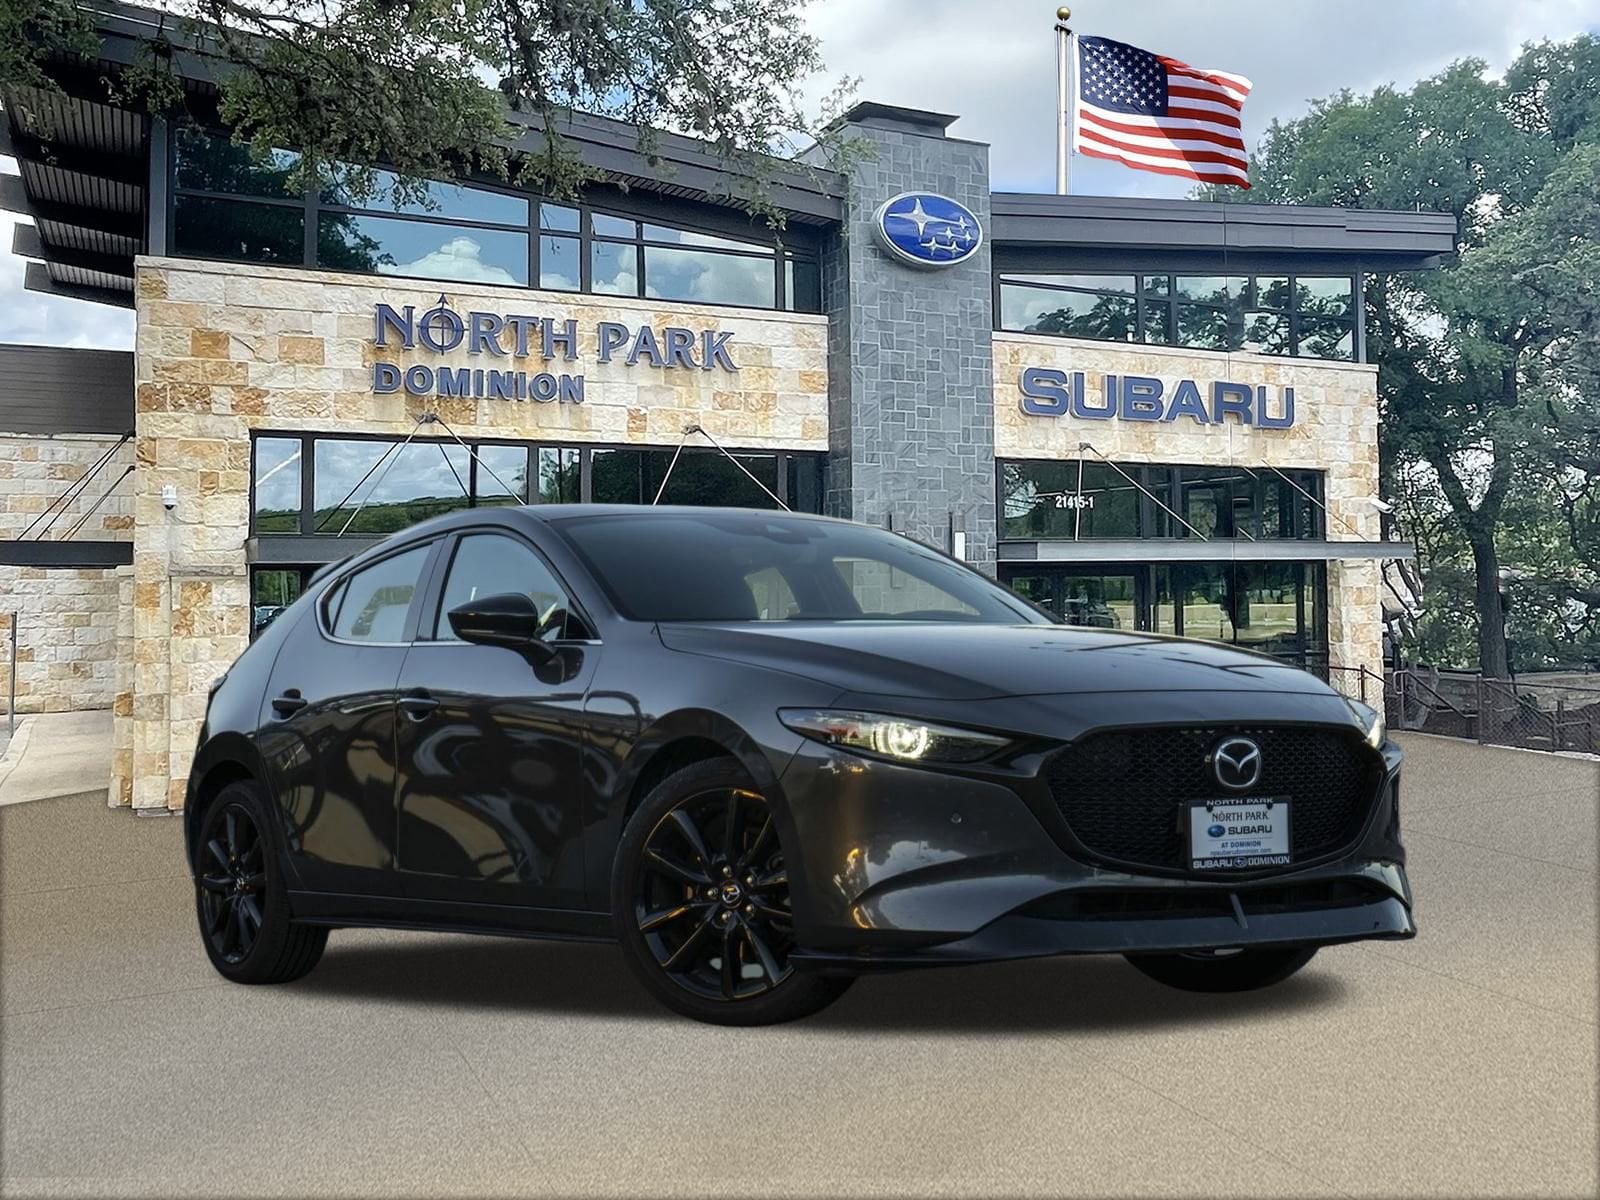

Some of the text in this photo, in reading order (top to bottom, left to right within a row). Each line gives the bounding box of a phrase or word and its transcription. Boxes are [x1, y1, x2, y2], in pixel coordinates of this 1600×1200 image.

[375, 293, 742, 373] NORTH PARK
[373, 361, 585, 404] DOMINION
[1018, 367, 1296, 430] SUBARU
[1212, 811, 1270, 822] NORTH PARK
[1228, 825, 1272, 835] SUBARU
[1230, 840, 1261, 848] DOMINION
[1193, 856, 1290, 869] SUBARU DOMINION
